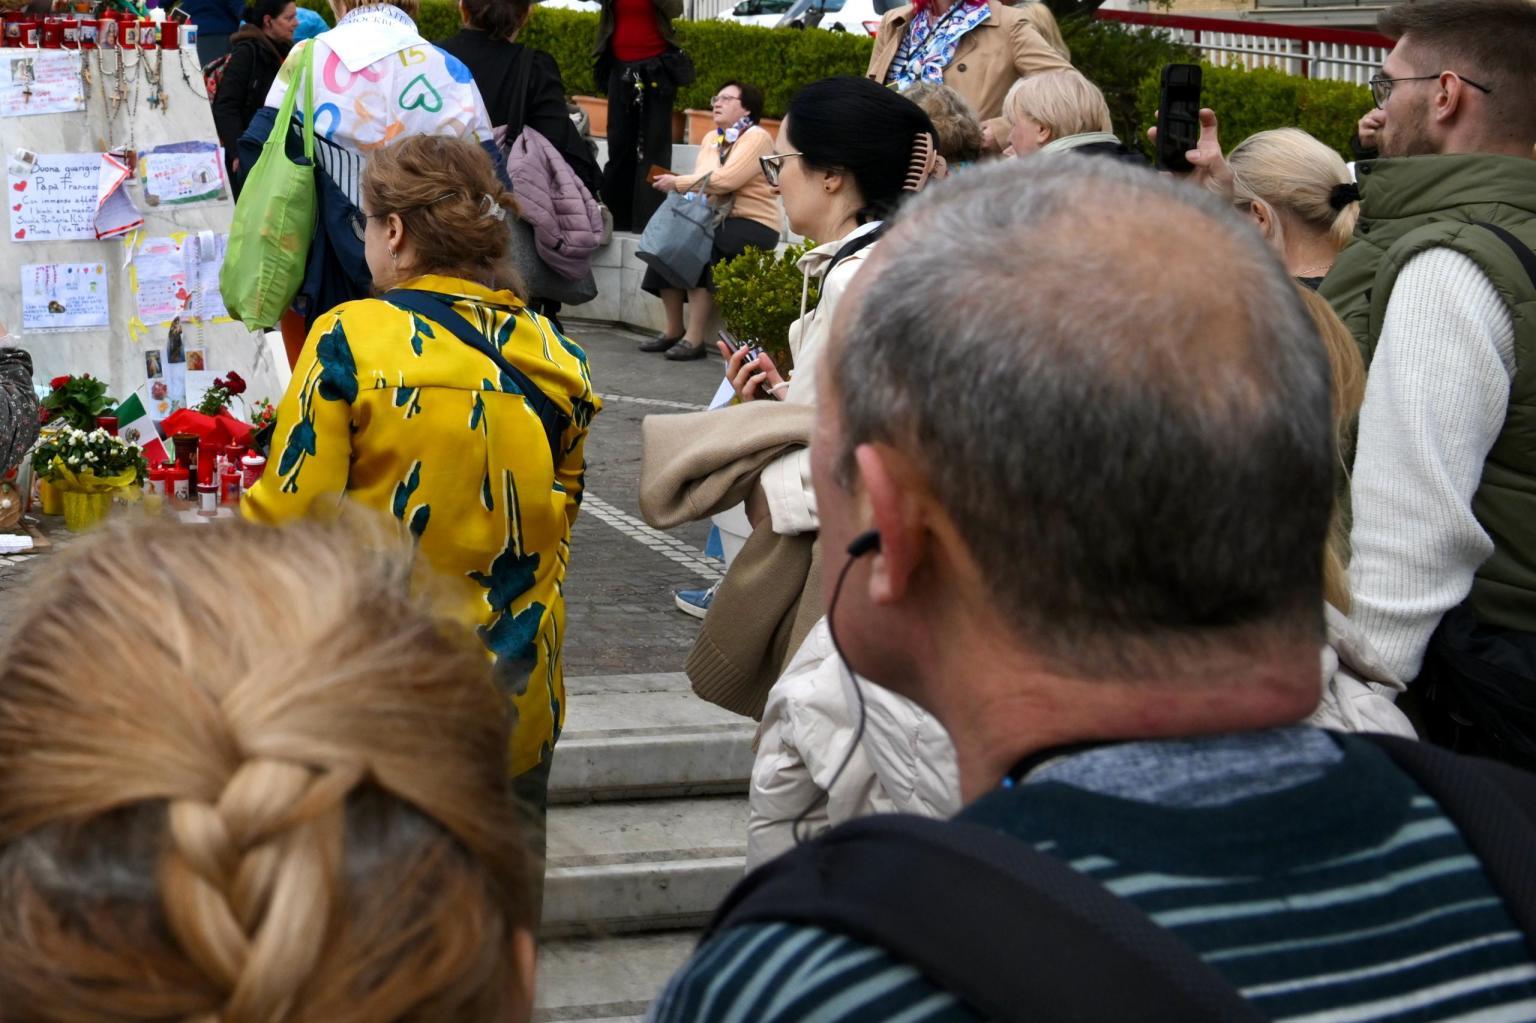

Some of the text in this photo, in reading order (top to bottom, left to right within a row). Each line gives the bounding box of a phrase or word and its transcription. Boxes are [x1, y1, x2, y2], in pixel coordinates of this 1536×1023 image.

[31, 160, 101, 177] Buona guarigio
[60, 177, 98, 191] Francesc
